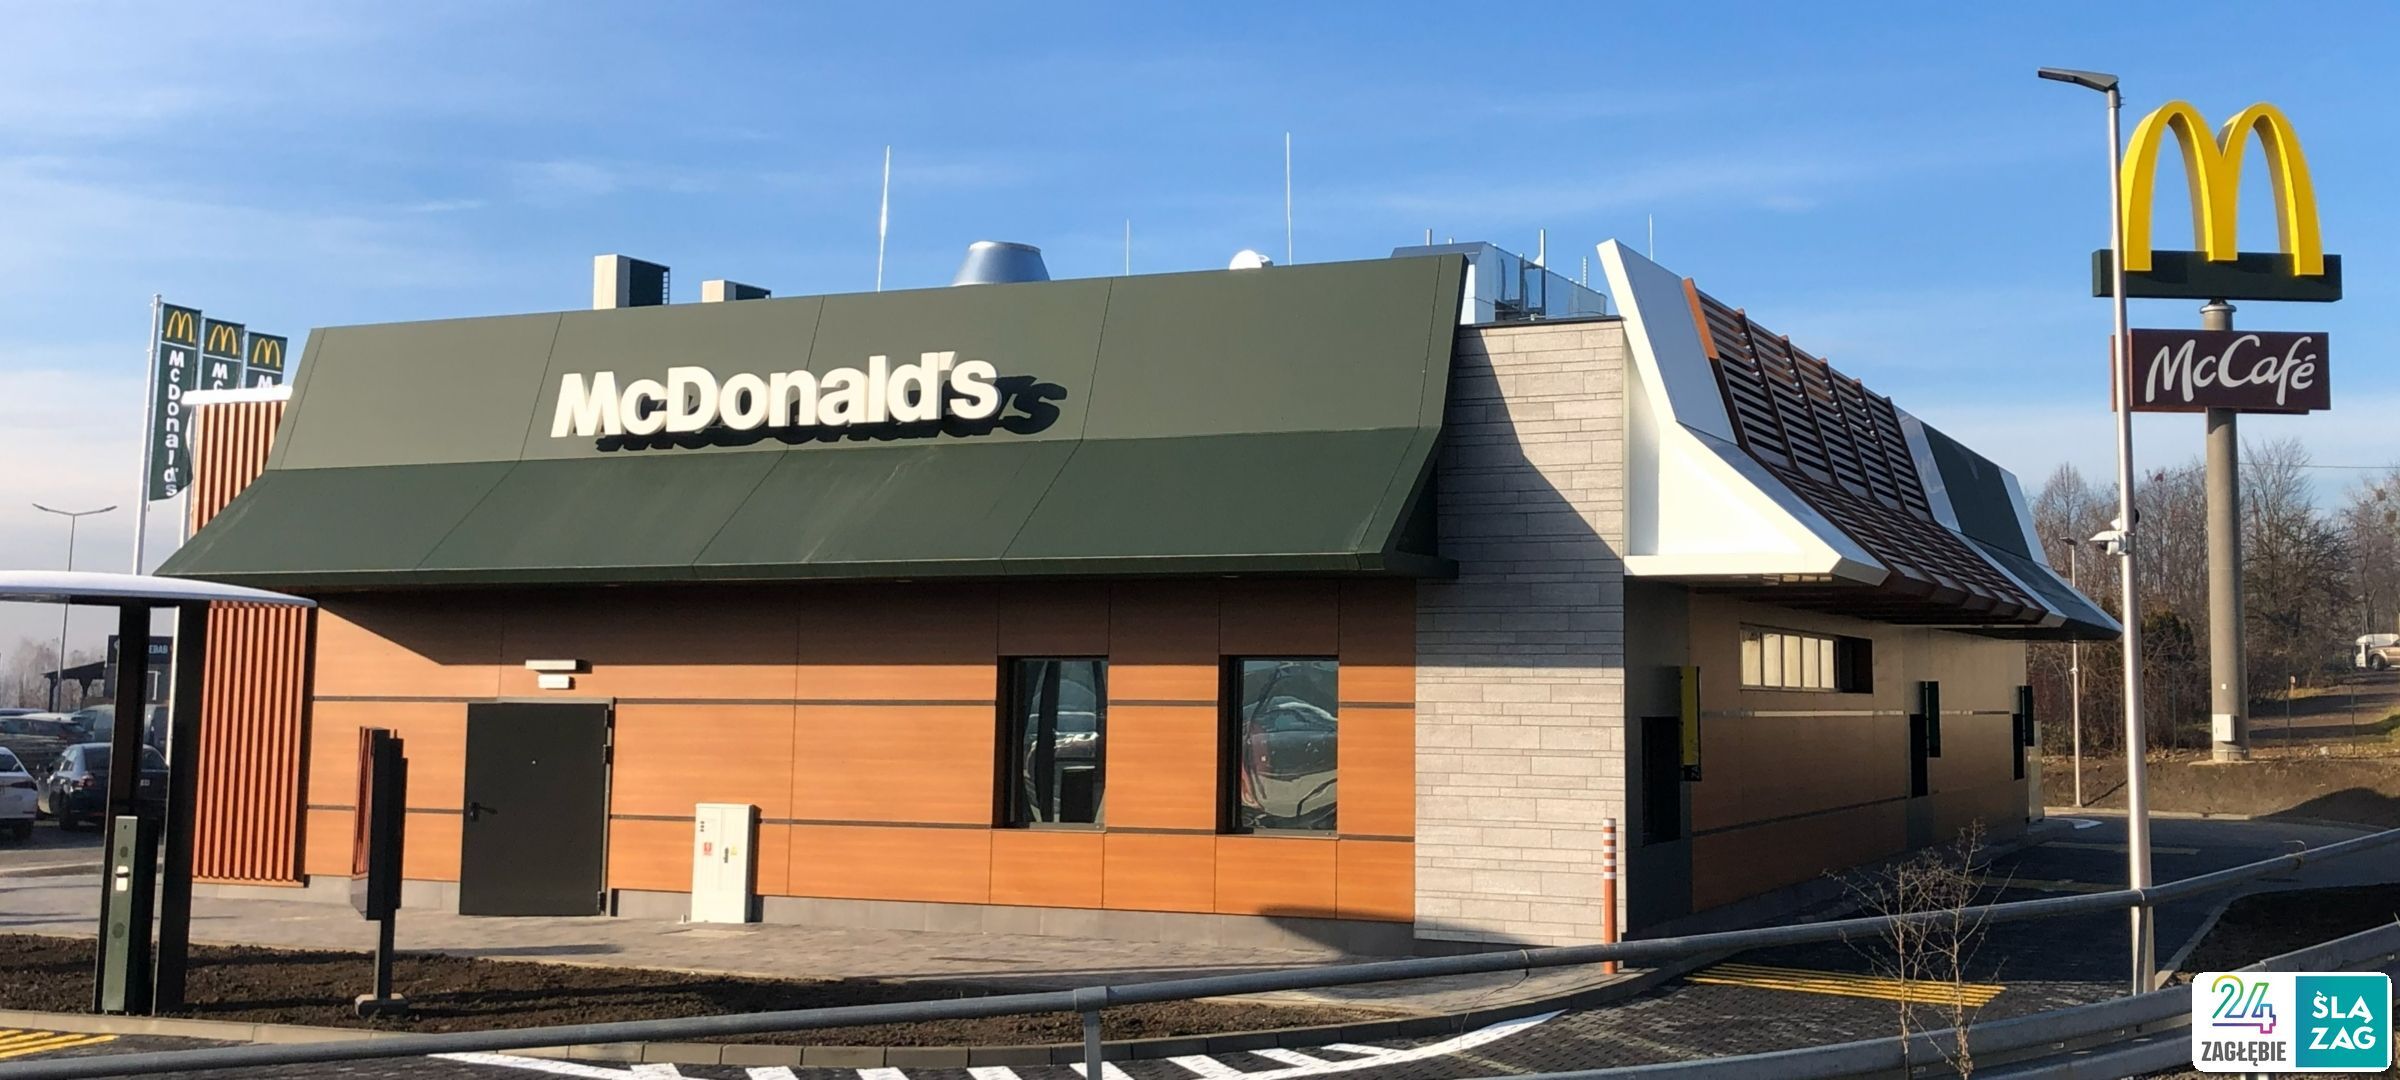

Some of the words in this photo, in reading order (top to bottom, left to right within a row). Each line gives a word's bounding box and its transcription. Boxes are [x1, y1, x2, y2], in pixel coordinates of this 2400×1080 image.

[550, 351, 1001, 438] McDonald's
[2145, 334, 2317, 406] McCafé
[149, 644, 168, 654] EBAB
